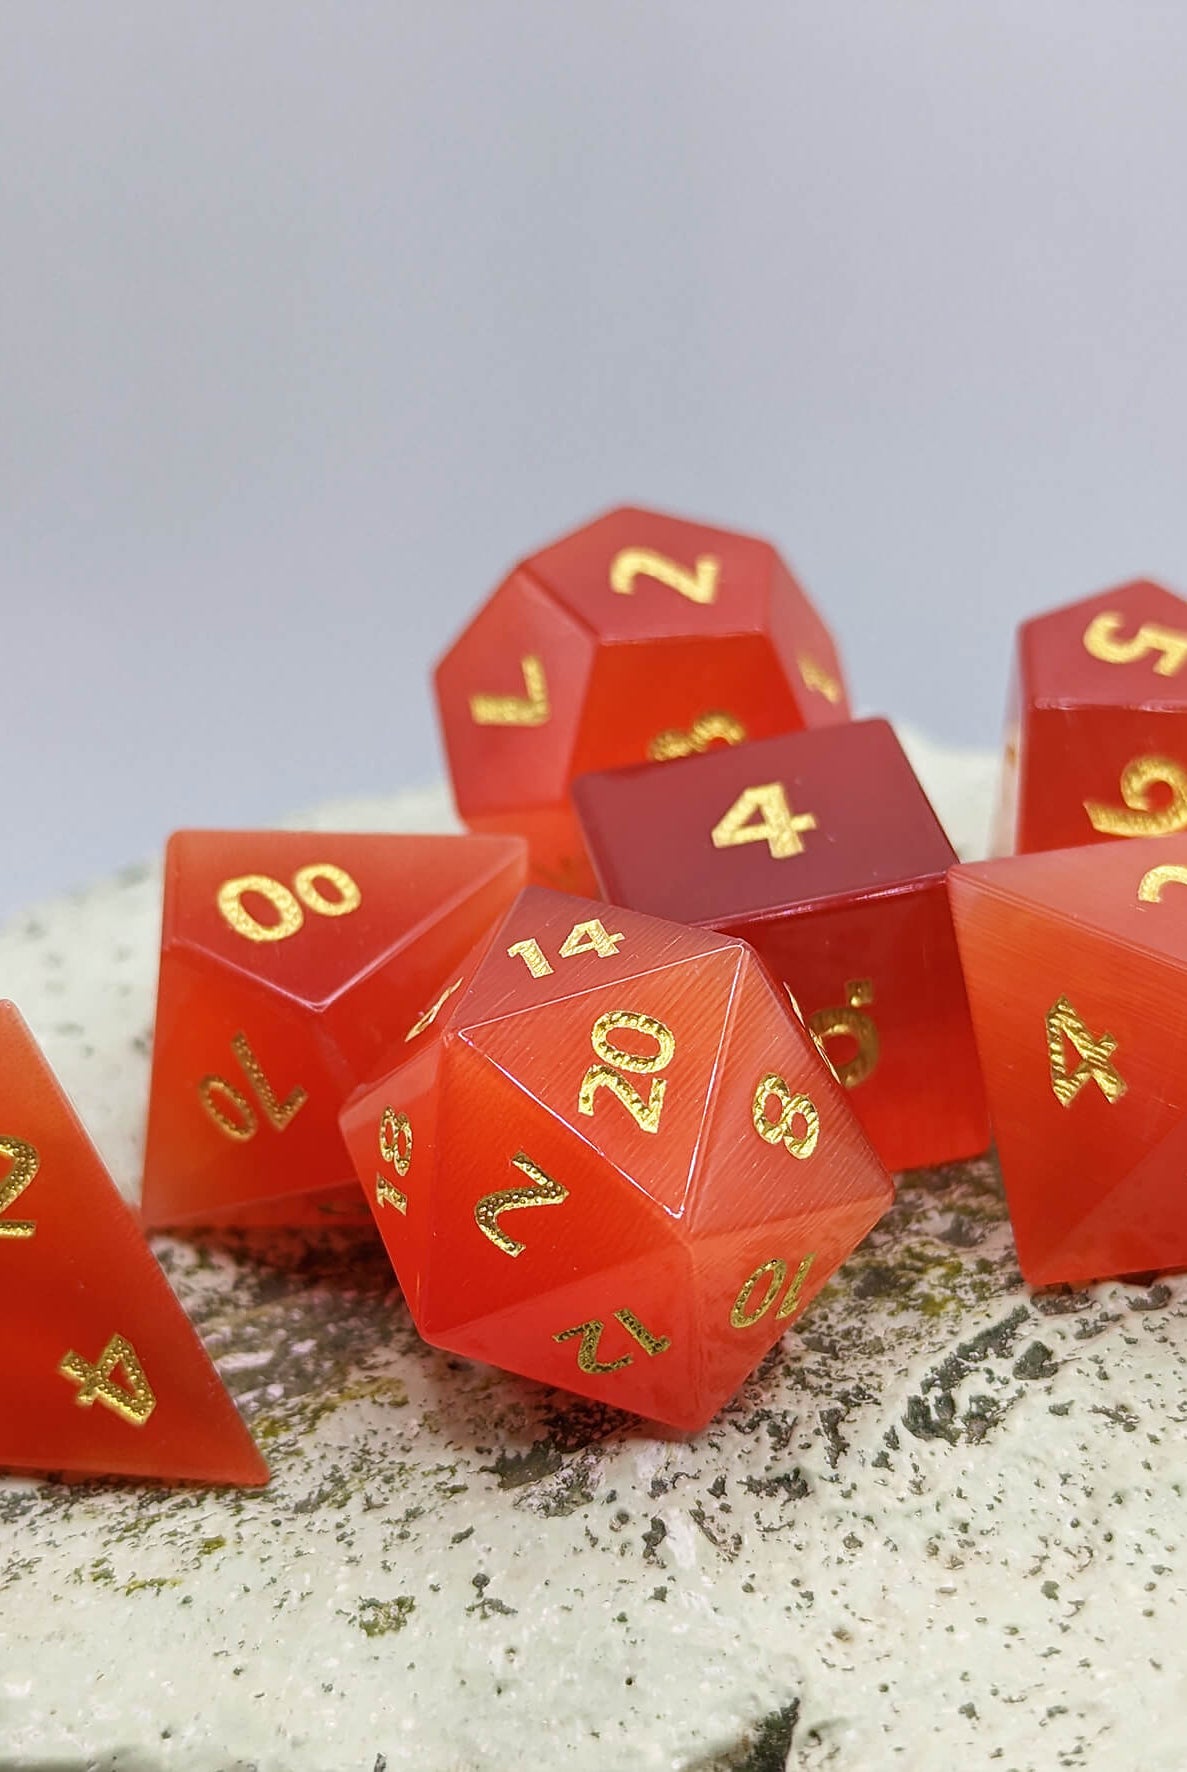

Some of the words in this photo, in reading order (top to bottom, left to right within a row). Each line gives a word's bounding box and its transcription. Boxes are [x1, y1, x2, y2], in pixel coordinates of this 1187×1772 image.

[611, 548, 719, 603] 2
[1083, 612, 1187, 677] 5
[470, 656, 549, 727] 7
[711, 783, 817, 859] 4
[217, 863, 361, 942] 00
[507, 919, 625, 979] 14
[578, 1010, 676, 1134] 20
[1048, 996, 1128, 1108] 4
[752, 1073, 820, 1160] 8
[376, 1104, 413, 1216] 18
[474, 1151, 571, 1258] 2
[730, 1254, 816, 1328] 10
[553, 1307, 671, 1374] 12
[59, 1333, 157, 1426] 4
